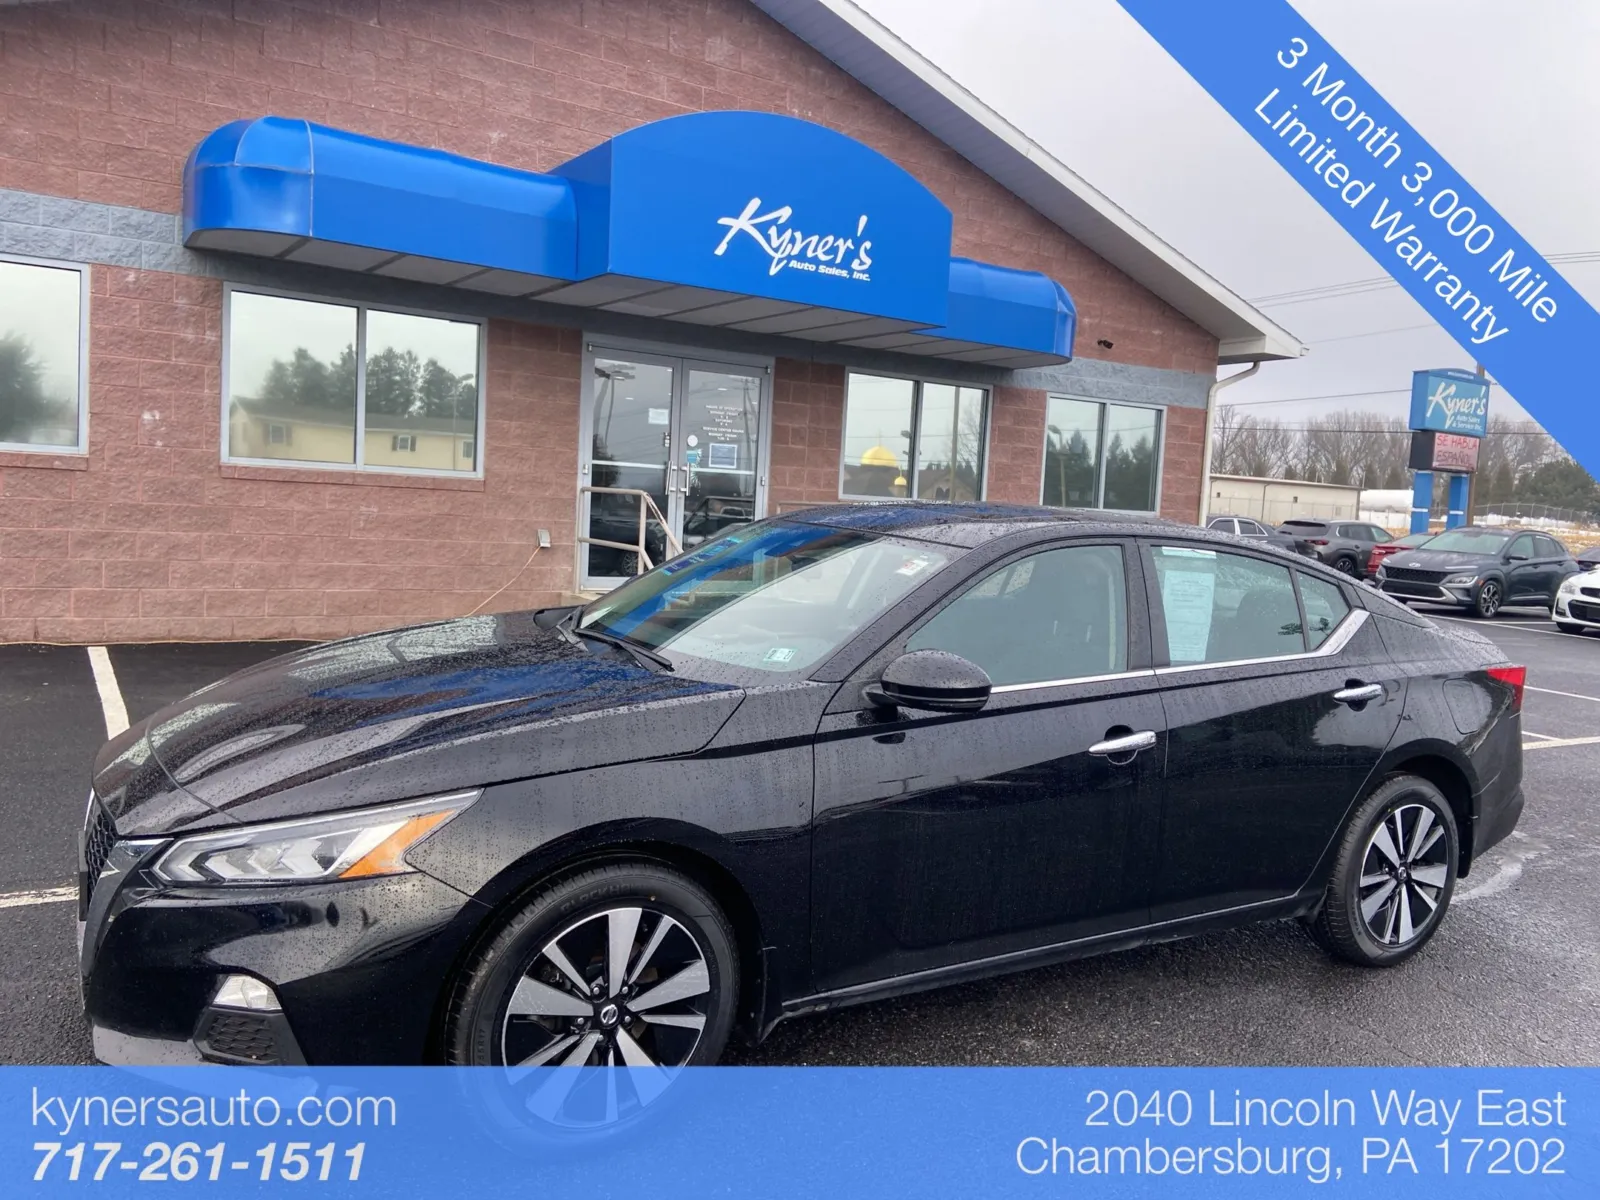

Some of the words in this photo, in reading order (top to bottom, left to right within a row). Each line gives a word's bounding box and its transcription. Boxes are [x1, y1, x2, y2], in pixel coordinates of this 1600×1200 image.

[714, 196, 872, 276] Kyner's
[788, 259, 816, 272] Auto
[817, 264, 850, 279] Sales,
[852, 270, 871, 282] Inc.
[1426, 382, 1486, 429] Kyner's
[1437, 435, 1449, 446] SE
[1452, 437, 1478, 450] HABLA
[1437, 450, 1475, 466] ESPAÑOL
